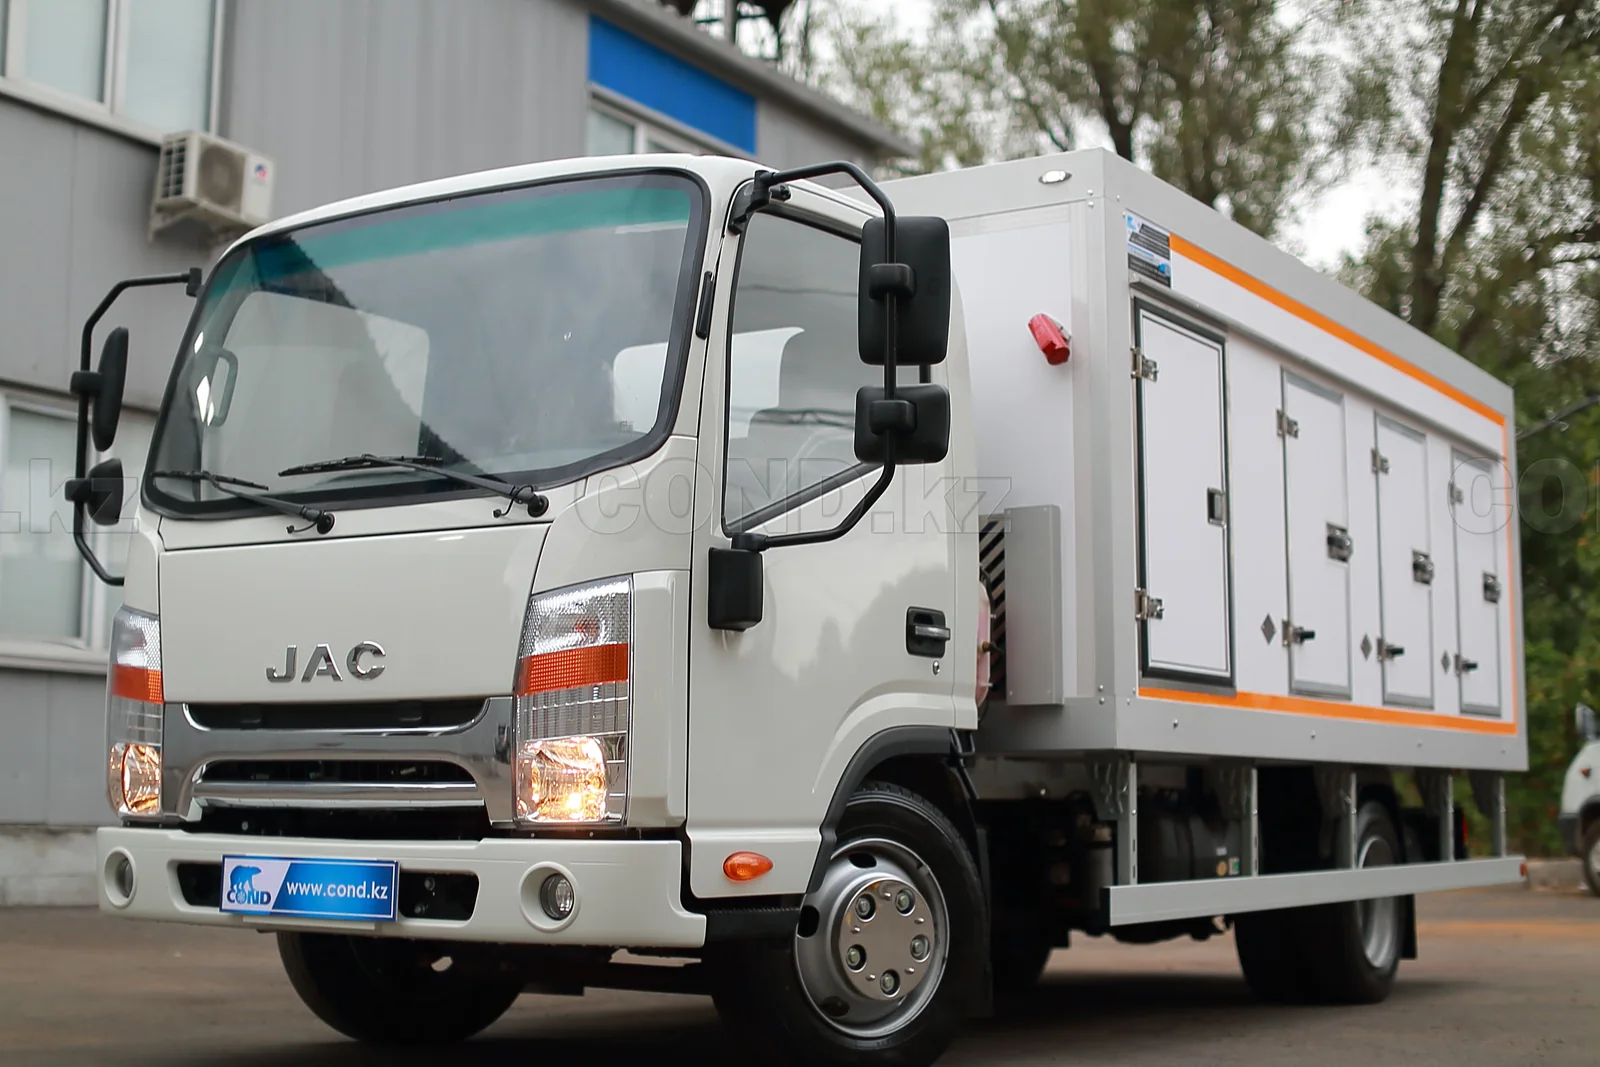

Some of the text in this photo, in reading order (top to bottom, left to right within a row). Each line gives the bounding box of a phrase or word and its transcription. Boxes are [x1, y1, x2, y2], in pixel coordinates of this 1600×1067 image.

[265, 640, 386, 683] JAC
[227, 889, 272, 905] COND
[286, 881, 388, 900] www.cond.kz
